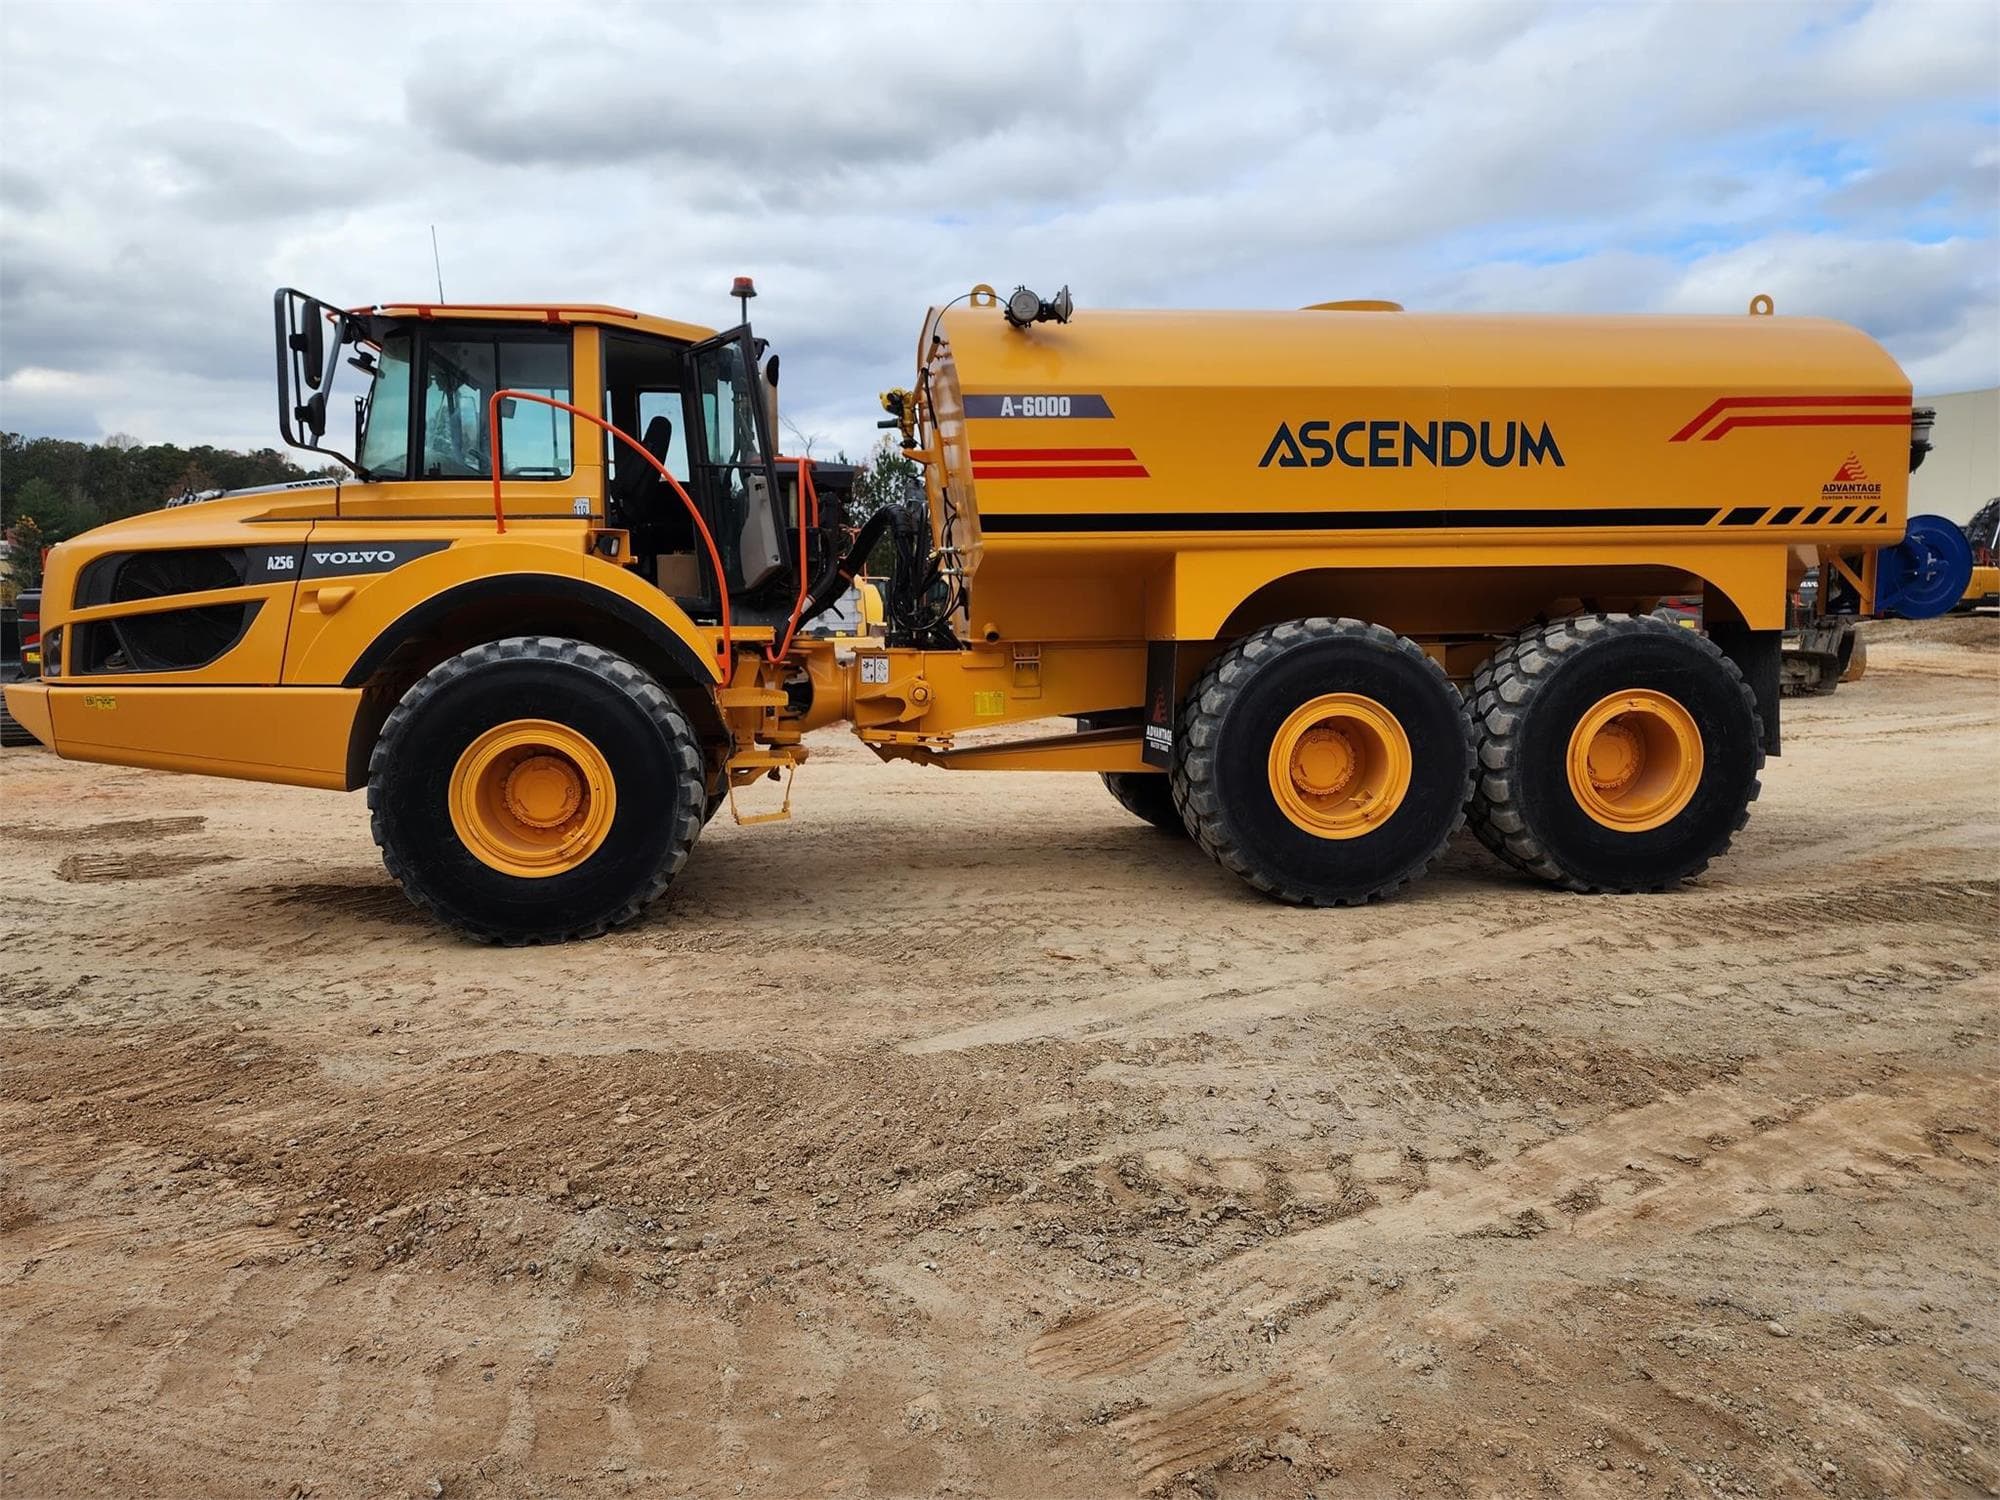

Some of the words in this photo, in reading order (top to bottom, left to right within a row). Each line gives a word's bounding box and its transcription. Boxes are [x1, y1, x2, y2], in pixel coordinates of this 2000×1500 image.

[1000, 396, 1071, 417] A-6000
[1257, 420, 1566, 468] ASCENDUM
[1822, 483, 1881, 492] ADVANTAGE
[266, 555, 295, 571] A25G
[312, 550, 396, 565] VOLVO
[1146, 724, 1172, 742] ADVANTAGE
